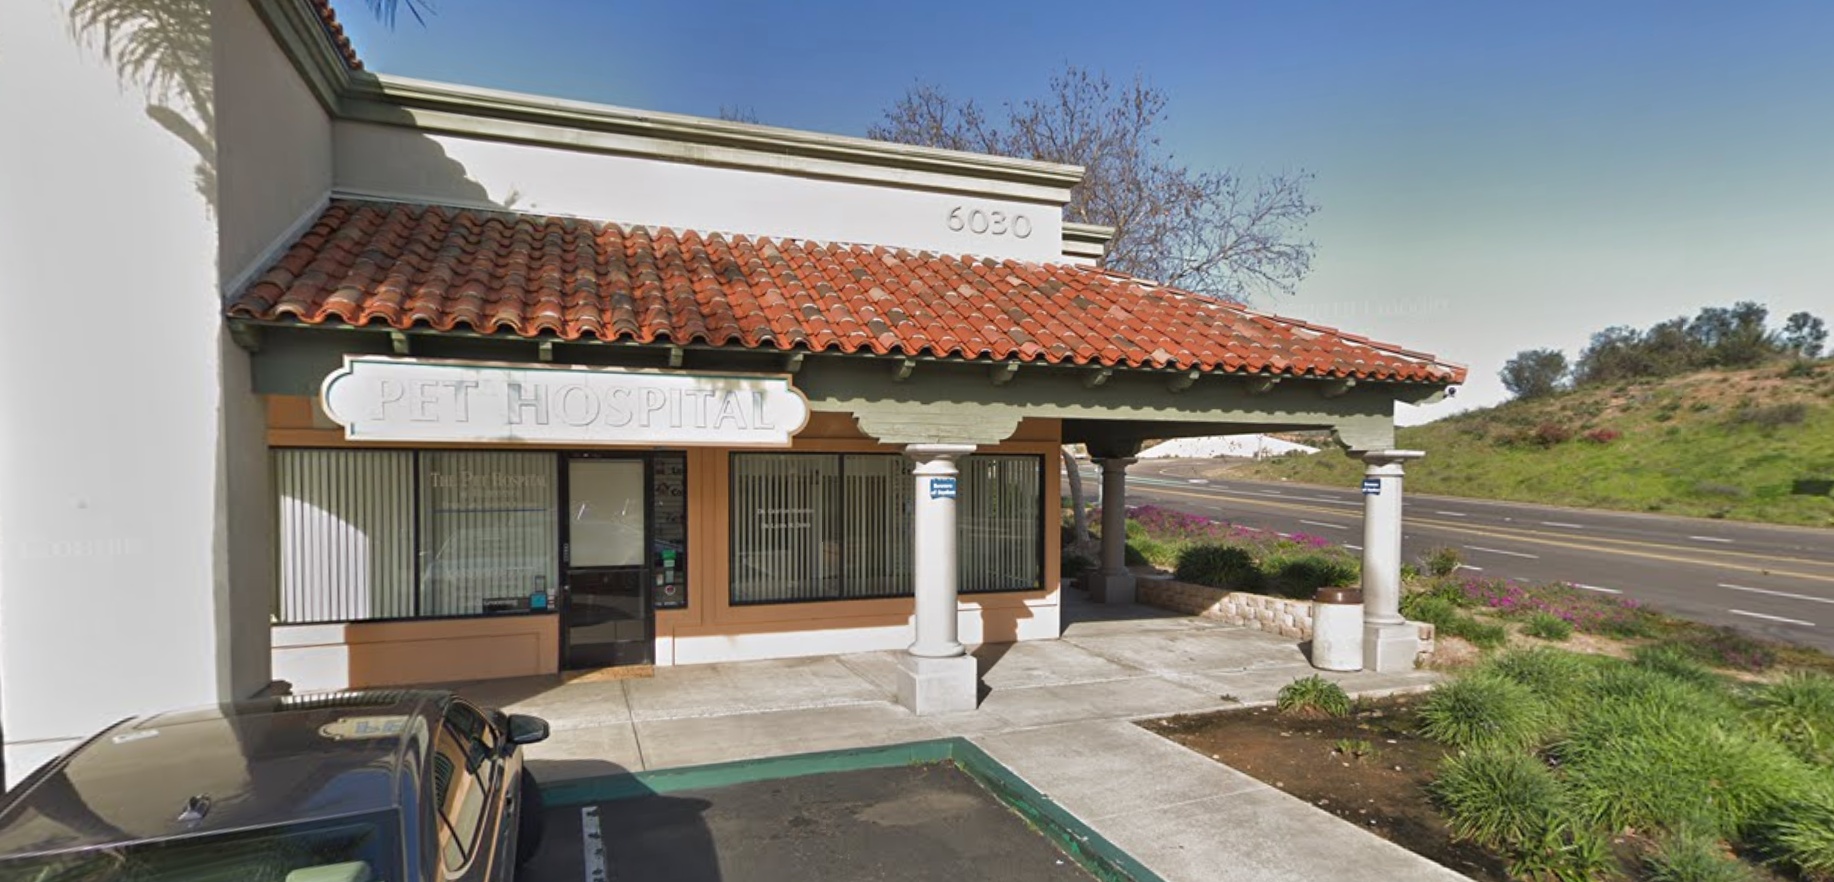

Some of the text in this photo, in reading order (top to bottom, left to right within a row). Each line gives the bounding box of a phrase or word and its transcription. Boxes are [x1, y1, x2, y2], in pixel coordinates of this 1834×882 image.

[946, 206, 1032, 239] 6030
[370, 379, 775, 430] PET HOSPITAL
